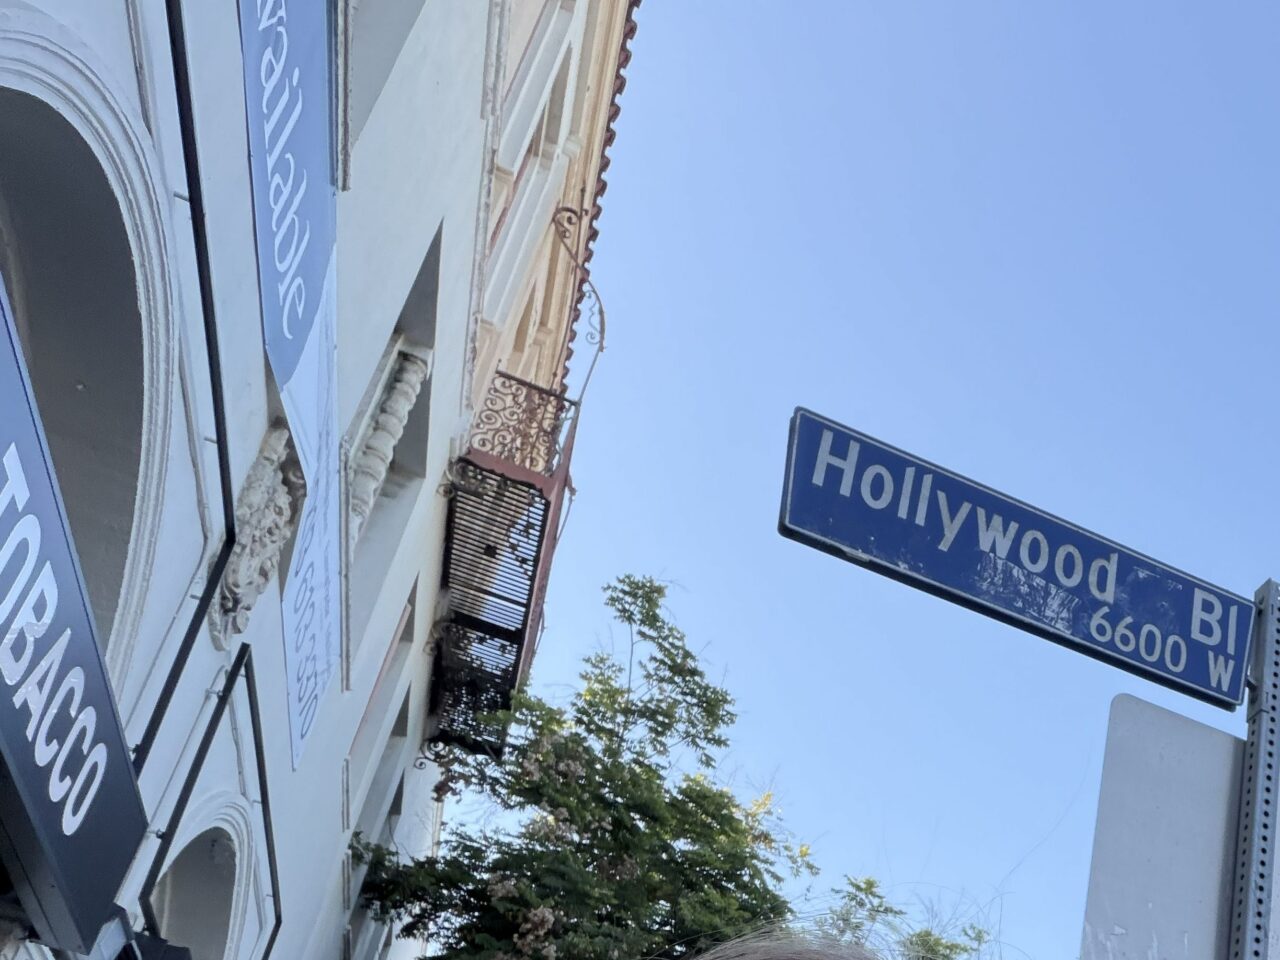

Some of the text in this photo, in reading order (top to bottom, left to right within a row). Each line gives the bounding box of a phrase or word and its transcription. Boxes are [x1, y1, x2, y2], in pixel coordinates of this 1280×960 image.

[257, 0, 310, 339] vailable
[812, 428, 1238, 655] Hollywood Bl
[1089, 606, 1235, 692] 6600 W
